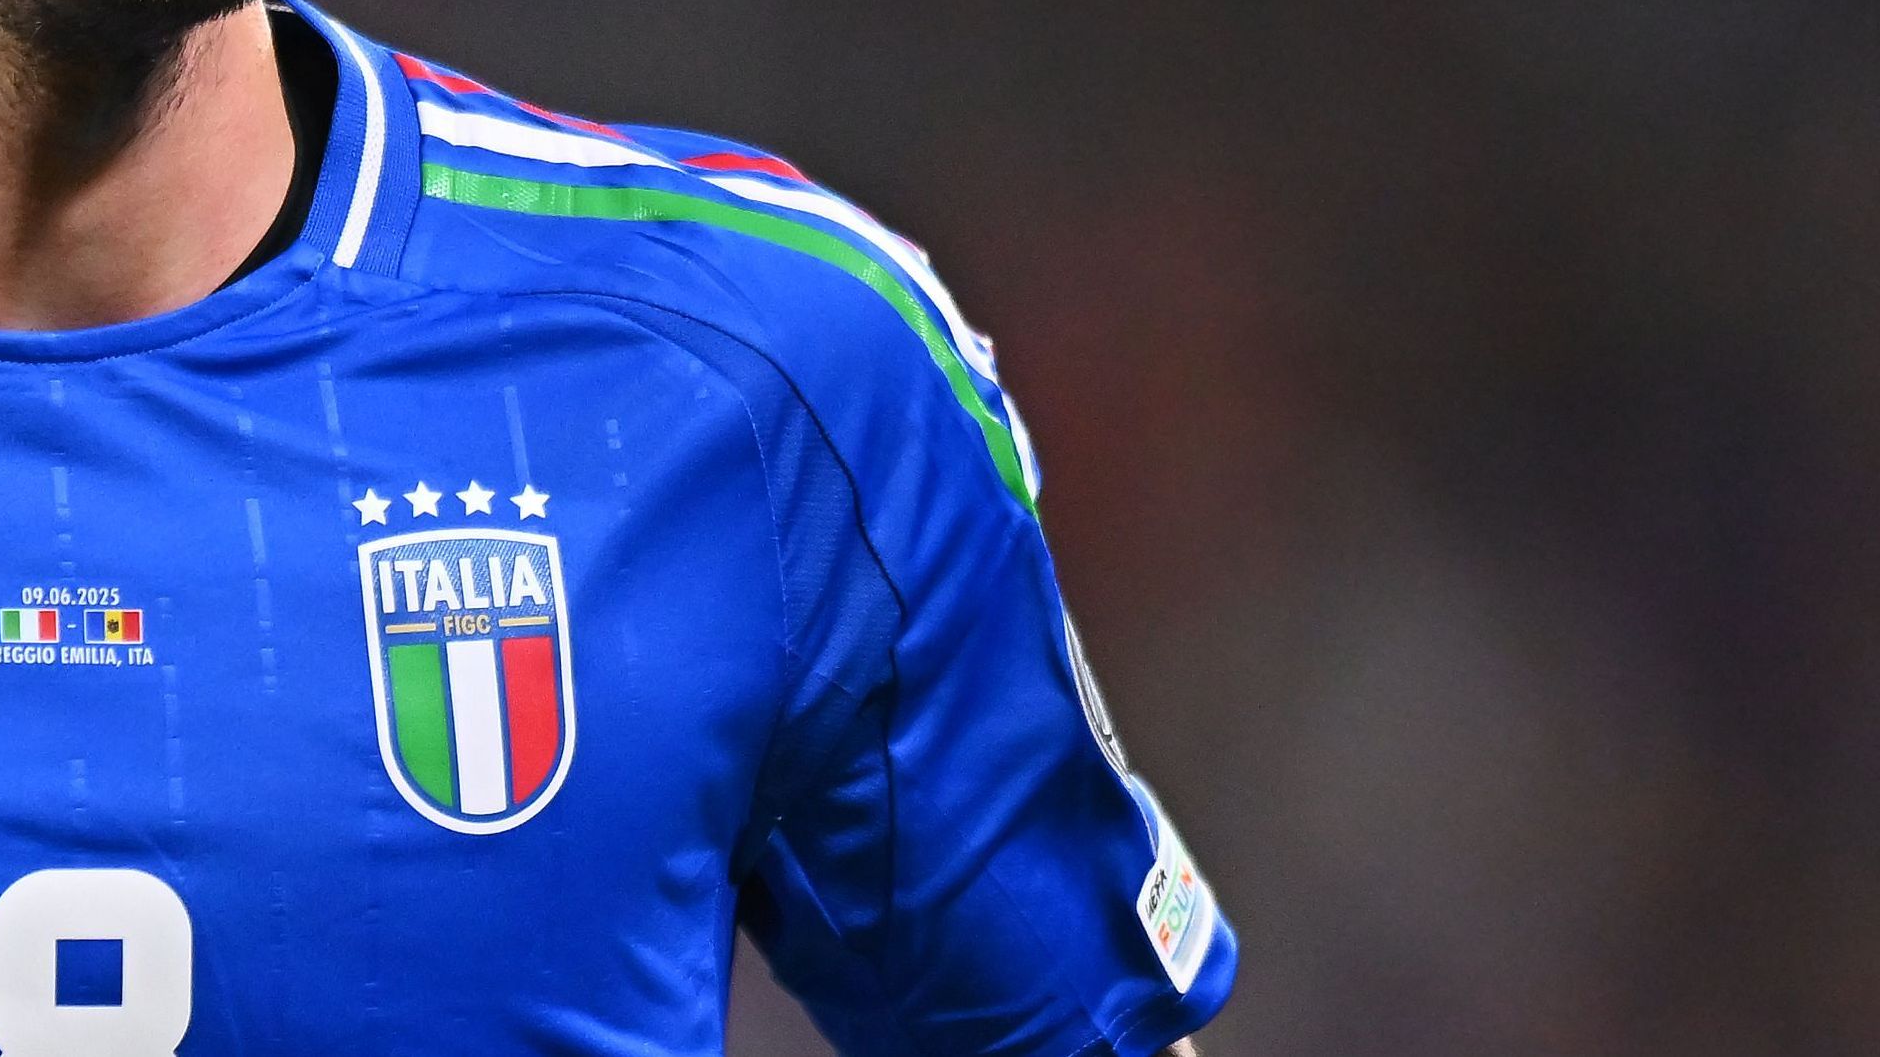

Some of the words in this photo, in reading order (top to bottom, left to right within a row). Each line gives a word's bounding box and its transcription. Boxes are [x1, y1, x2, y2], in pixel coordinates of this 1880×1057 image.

[377, 554, 549, 613] ITALIA
[21, 587, 120, 606] 09.06.2025
[443, 614, 492, 637] FIGC
[61, 646, 123, 667] EMILIA,
[128, 647, 155, 665] ITA
